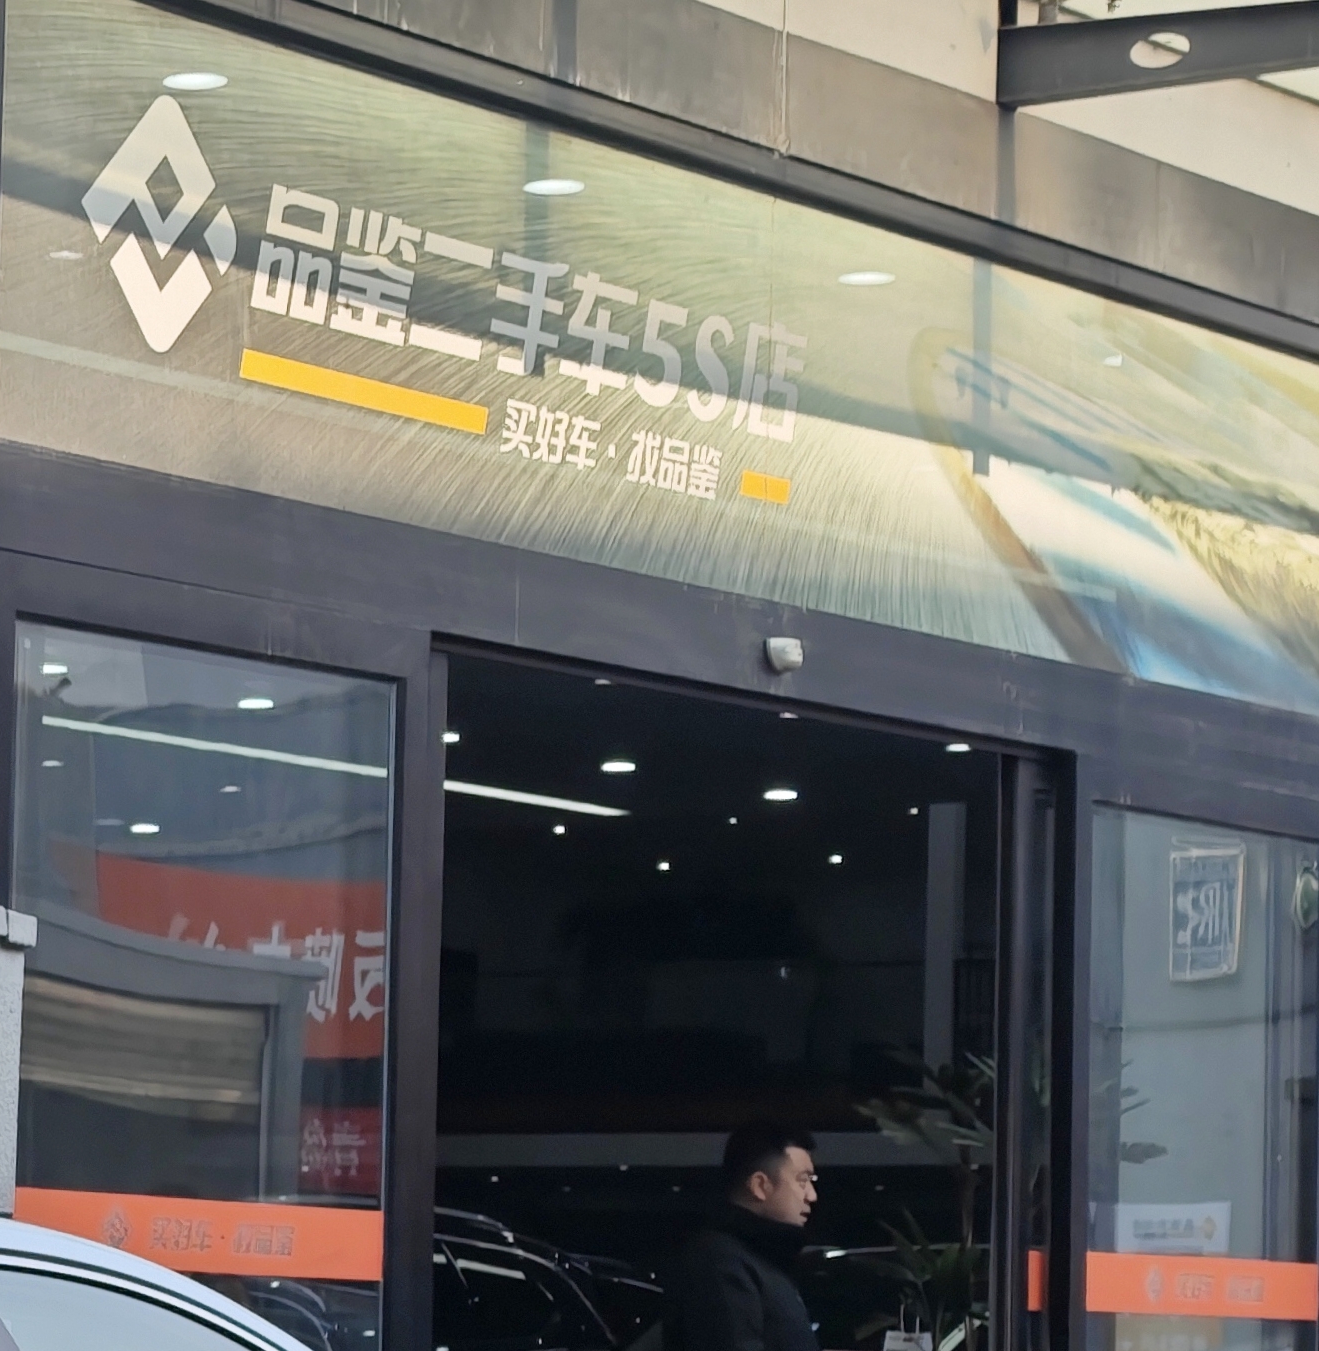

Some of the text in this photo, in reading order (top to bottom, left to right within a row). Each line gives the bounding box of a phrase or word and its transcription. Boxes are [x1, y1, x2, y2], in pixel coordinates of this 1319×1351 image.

[250, 183, 809, 443] 品鉴二手车5S店
